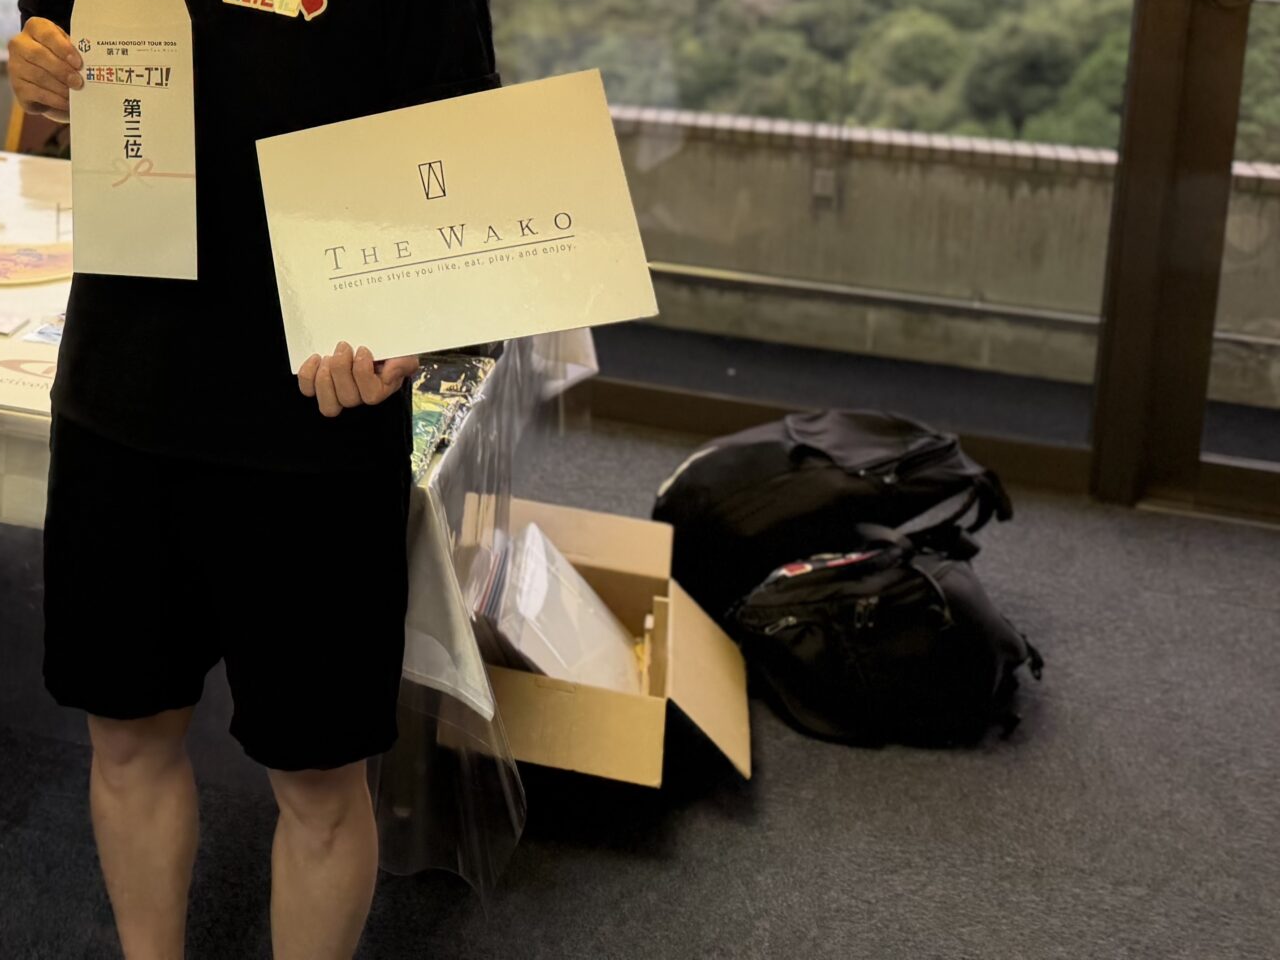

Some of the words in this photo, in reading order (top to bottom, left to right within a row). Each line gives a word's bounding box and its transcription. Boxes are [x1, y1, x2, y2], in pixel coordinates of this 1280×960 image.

[122, 98, 143, 159] 第三位
[324, 240, 412, 271] THE
[436, 212, 572, 250] WAKO
[333, 279, 363, 291] select
[366, 276, 383, 285] the
[387, 270, 411, 281] style
[415, 267, 433, 277] you
[437, 262, 460, 271] like,
[489, 252, 514, 264] play,
[518, 248, 538, 258] and
[542, 243, 576, 254] enjoy.
